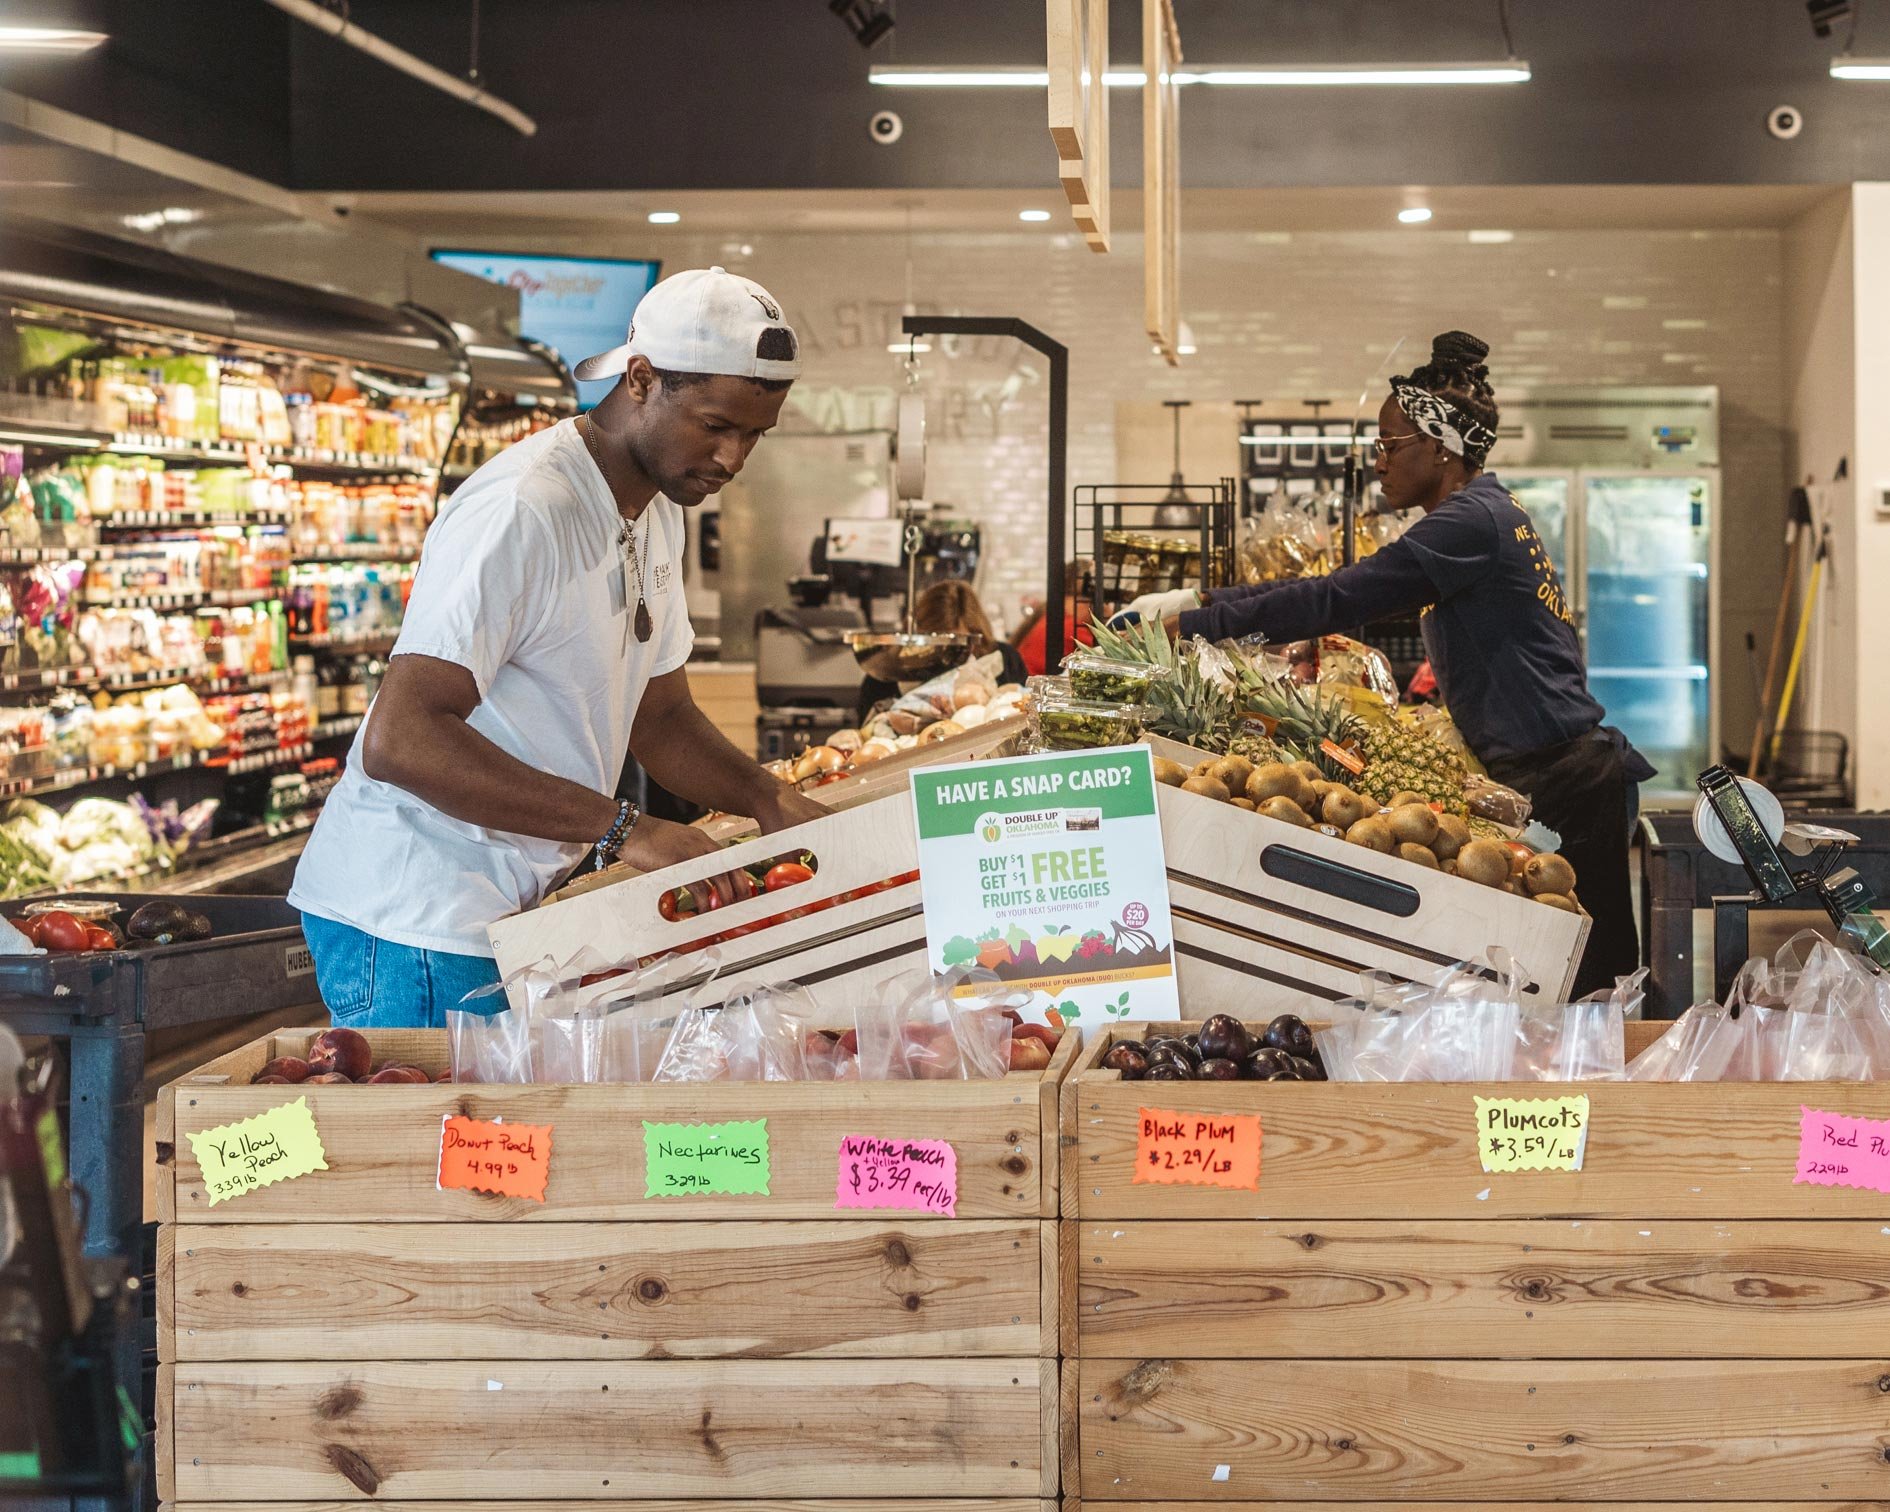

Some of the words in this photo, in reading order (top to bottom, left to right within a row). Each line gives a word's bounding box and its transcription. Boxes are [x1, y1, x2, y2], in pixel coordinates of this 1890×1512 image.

[936, 780, 990, 806] HAVE
[994, 778, 1008, 799] A
[1011, 773, 1064, 797] SNAP
[1068, 765, 1132, 791] CARD?
[1005, 813, 1043, 825] DOUBLE
[1045, 811, 1059, 820] UP
[1006, 821, 1059, 834] OKLAHOMA
[979, 855, 1008, 873] BUY
[1010, 854, 1025, 869] $1
[1031, 846, 1108, 885] FREE
[981, 874, 1007, 891] GET
[1013, 871, 1027, 886] $1
[983, 889, 1032, 908] FRUITS
[1035, 888, 1047, 903] &
[1049, 881, 1111, 902] VEGGIES
[995, 911, 1007, 919] ON
[1007, 908, 1028, 917] YOUR
[1028, 906, 1046, 915] NEXT
[1047, 902, 1084, 913] SHOPPING
[1084, 900, 1100, 909] TRIP
[1126, 909, 1145, 920] $20
[1029, 980, 1052, 989] DOUBLE
[1062, 977, 1096, 985] OKLAHOMA
[1144, 1119, 1186, 1141] Black
[1488, 1106, 1582, 1131] Plumcots
[209, 1133, 275, 1167] Yellow
[498, 1133, 537, 1161] Peach
[1823, 1124, 1859, 1148] Red
[1870, 1136, 1890, 1157] Plu
[244, 1142, 288, 1173] Peach
[659, 1141, 761, 1164] Nectarines
[847, 1140, 902, 1157] White
[902, 1144, 945, 1168] Peach
[467, 1160, 503, 1179] 4.99
